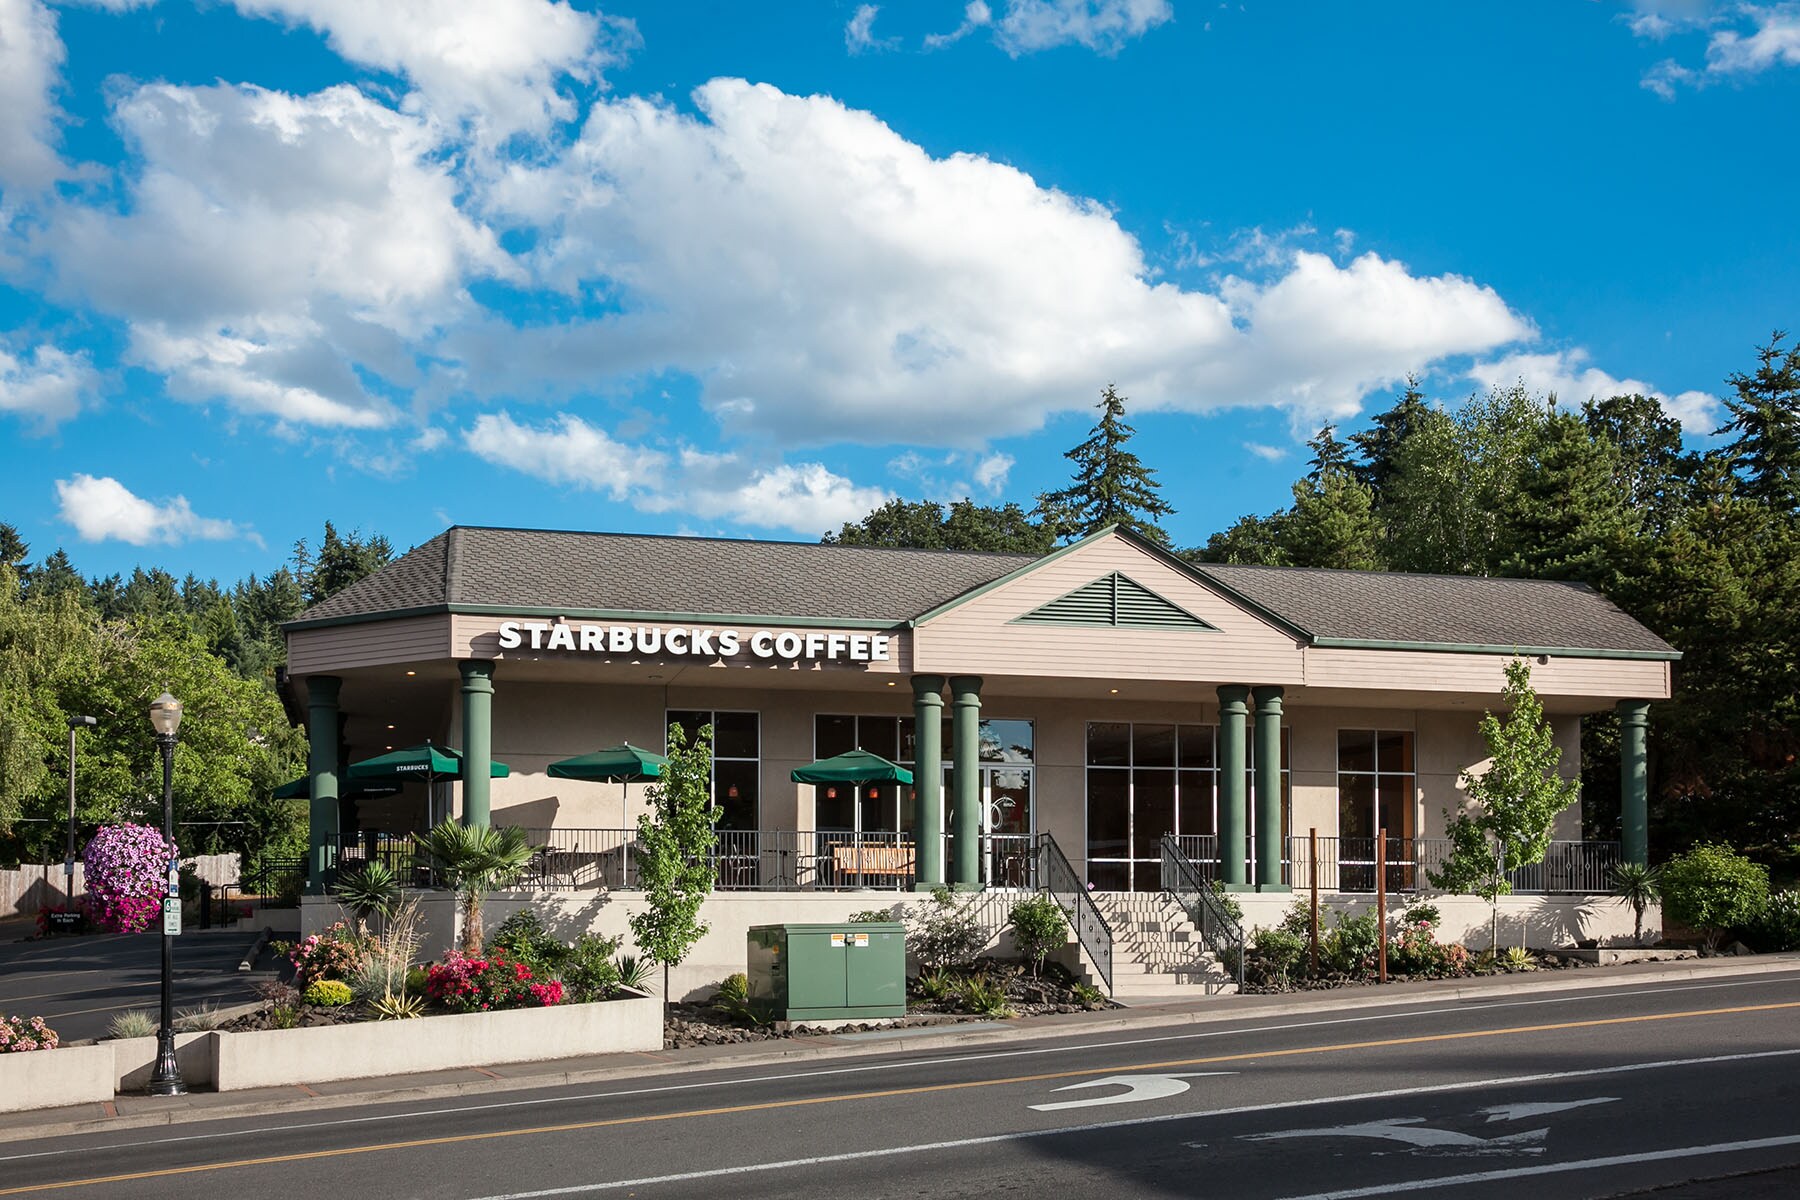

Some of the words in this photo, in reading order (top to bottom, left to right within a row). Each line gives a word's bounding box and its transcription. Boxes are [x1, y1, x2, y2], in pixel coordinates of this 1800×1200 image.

[498, 621, 740, 656] STARBUCKS
[751, 630, 890, 661] COFFEE
[396, 764, 429, 772] STARBUCKS
